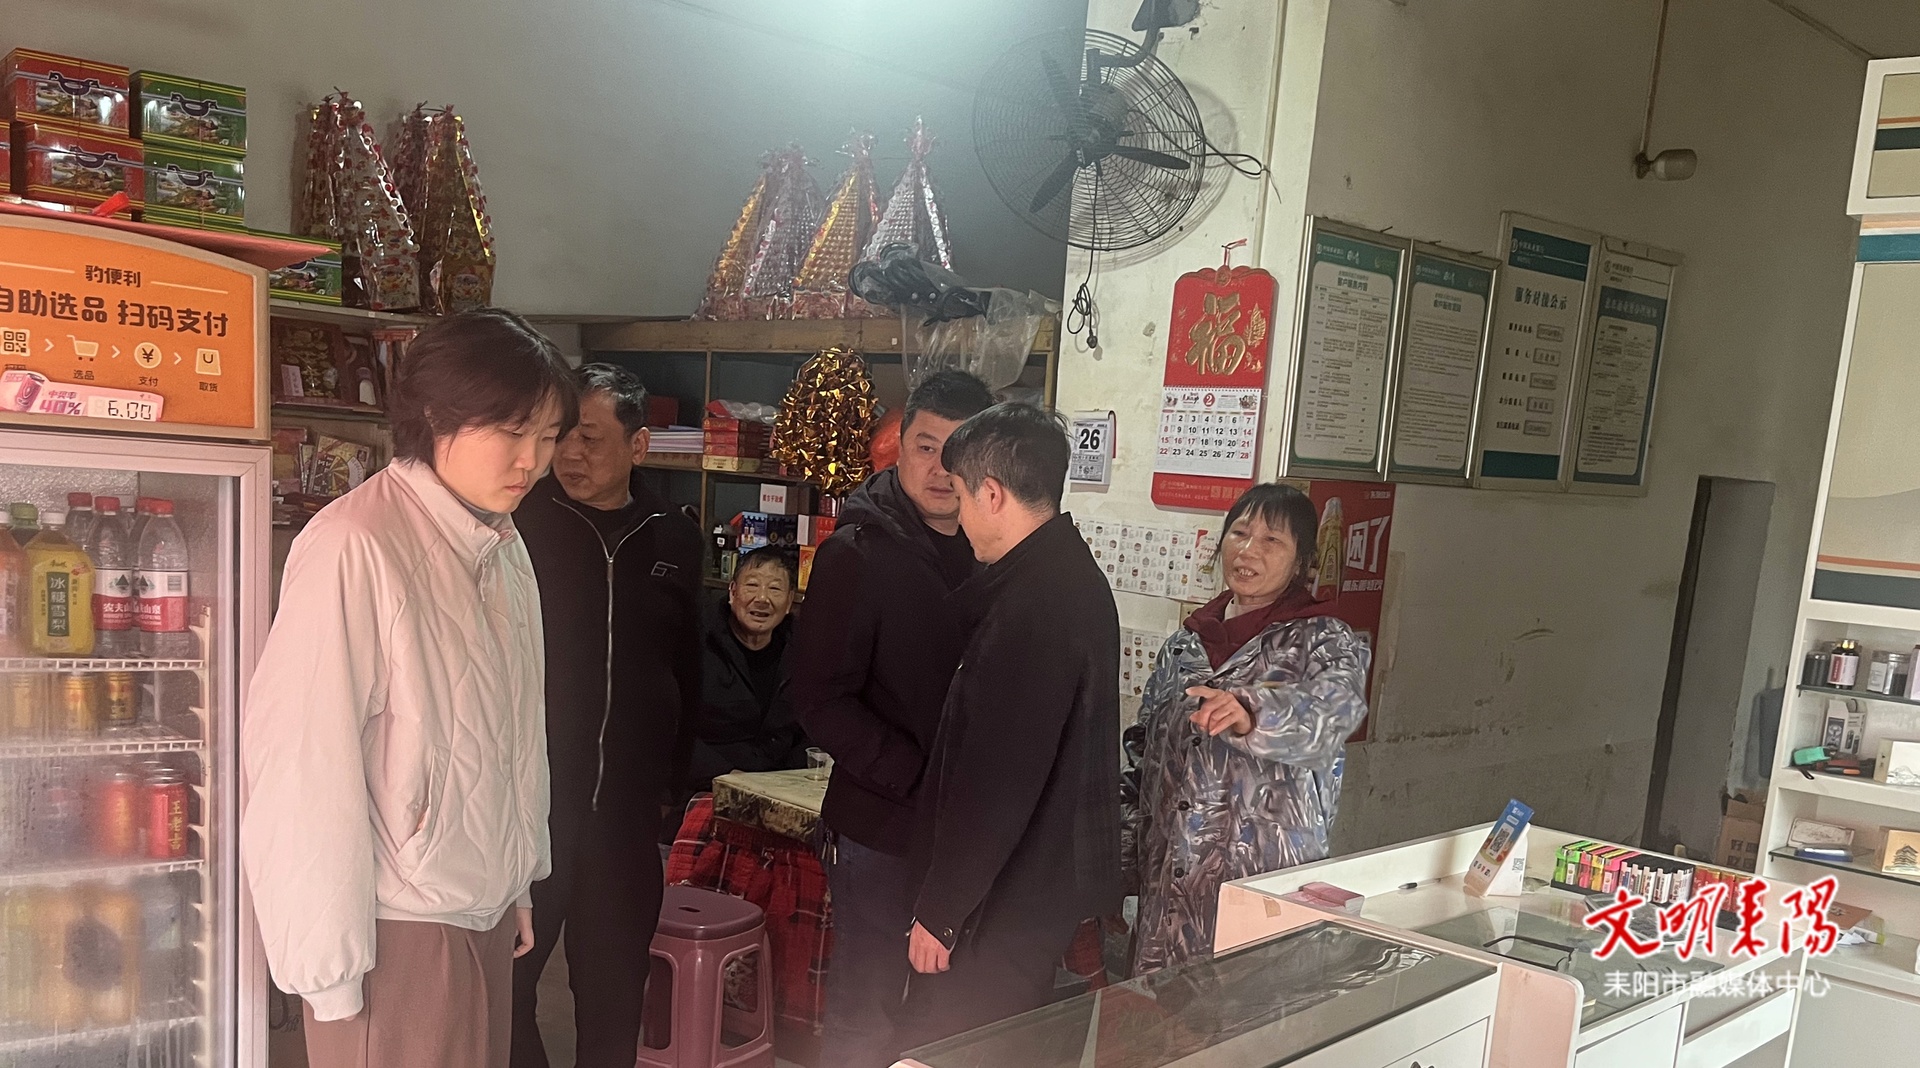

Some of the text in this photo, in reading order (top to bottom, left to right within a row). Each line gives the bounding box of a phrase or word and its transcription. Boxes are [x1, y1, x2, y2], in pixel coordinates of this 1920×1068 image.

[85, 264, 141, 288] 豹便利
[0, 287, 229, 337] 自助选品 扫码支付
[73, 369, 95, 380] 选品
[138, 376, 158, 387] 支付
[199, 381, 218, 392] 取货
[39, 400, 82, 416] 40%
[108, 400, 152, 420] 6.00
[1204, 394, 1213, 406] 2
[1079, 428, 1101, 450] 26
[50, 576, 66, 631] 冰糖雪梨
[168, 800, 183, 850] 王老吉
